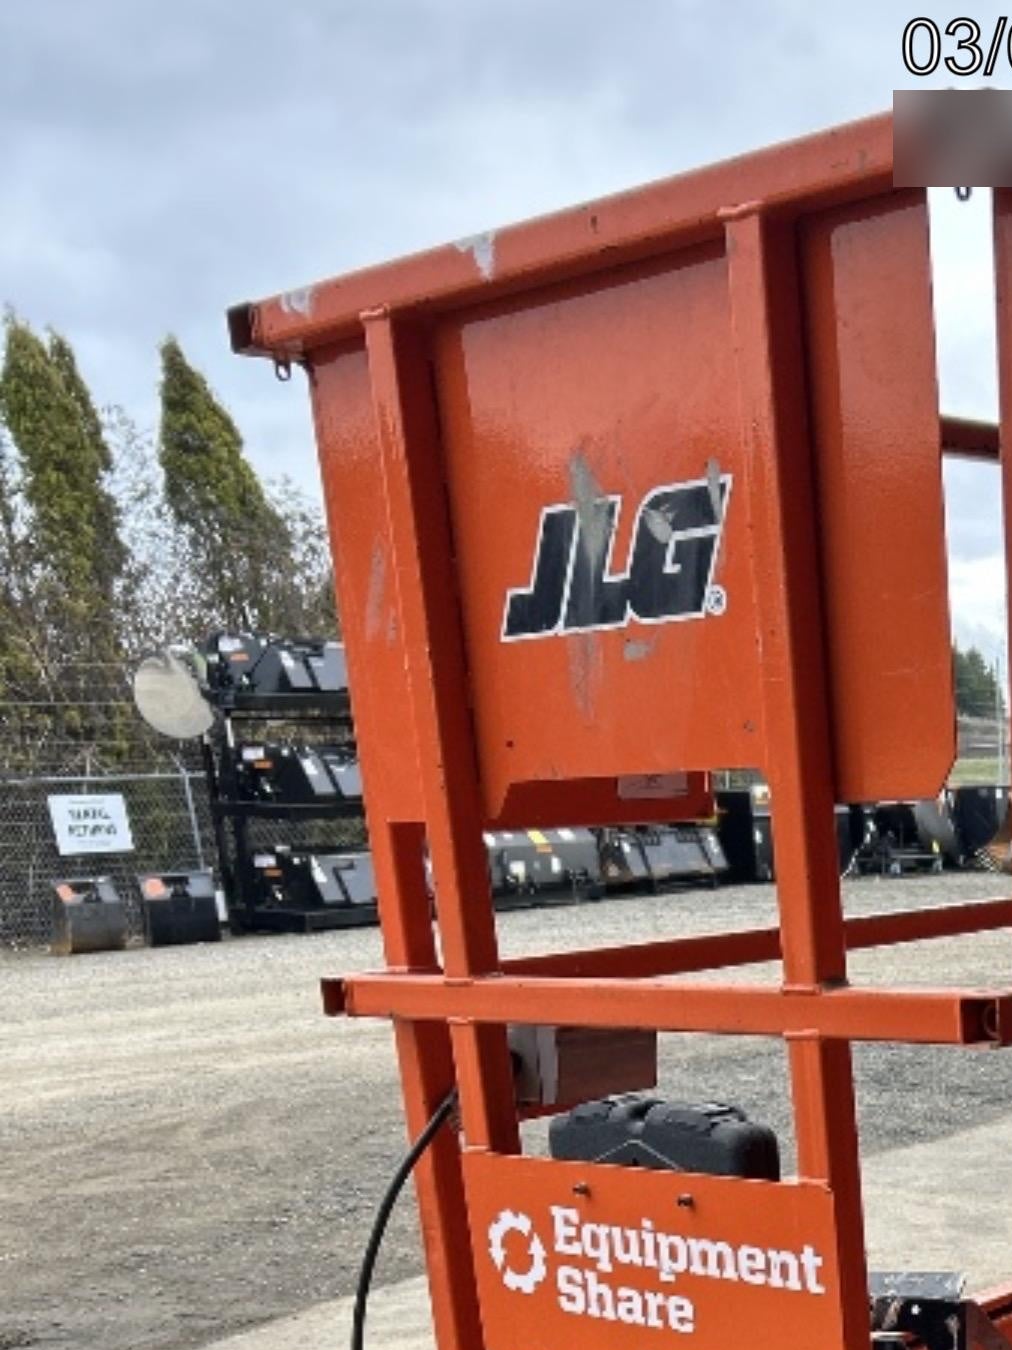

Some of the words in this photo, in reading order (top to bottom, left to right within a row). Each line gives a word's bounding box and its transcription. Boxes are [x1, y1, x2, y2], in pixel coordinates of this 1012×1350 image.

[500, 474, 733, 642] JLG
[551, 1206, 825, 1294] Equipment
[557, 1265, 695, 1333] Share
